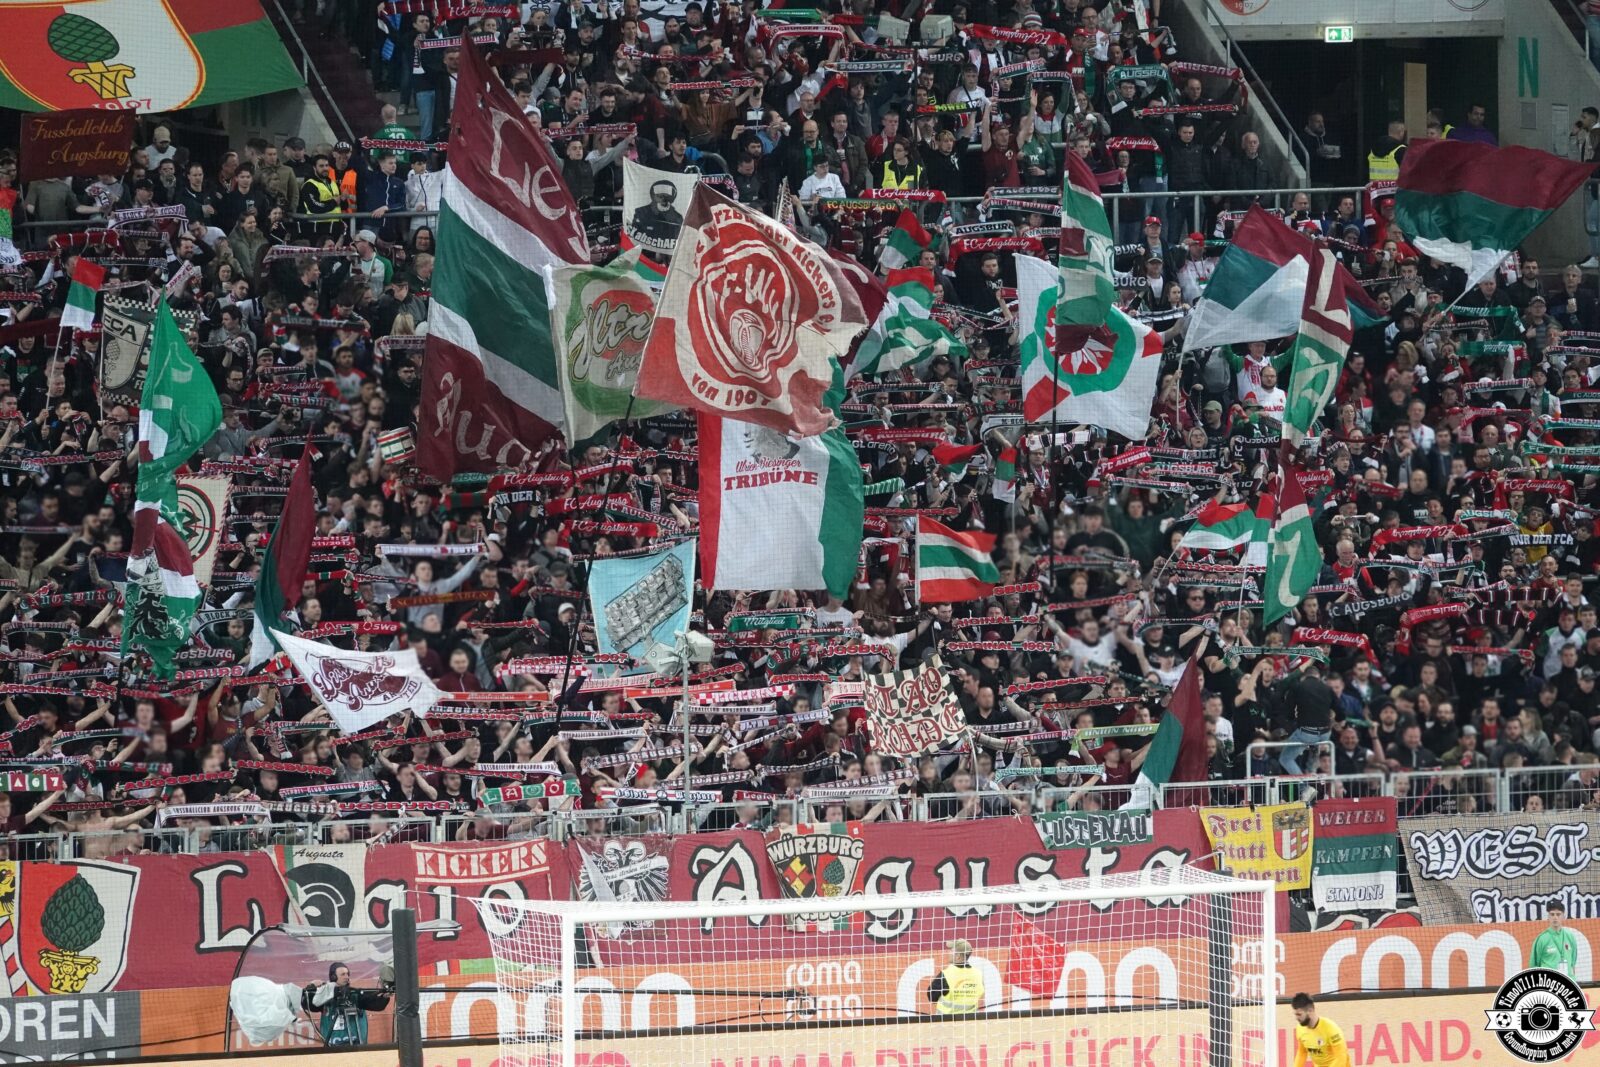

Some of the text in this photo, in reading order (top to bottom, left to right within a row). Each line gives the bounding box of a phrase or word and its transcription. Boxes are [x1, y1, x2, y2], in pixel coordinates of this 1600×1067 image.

[992, 26, 1036, 44] Augsburg
[1518, 37, 1539, 98] N
[936, 103, 967, 111] POWER
[30, 114, 125, 141] Fussballclub
[47, 142, 130, 166] Augsburg
[888, 187, 936, 199] Augsburg
[979, 238, 1030, 250] Augsburg
[792, 244, 837, 310] Kickers
[691, 372, 773, 407] von 1907
[522, 473, 571, 487] Augsburg
[724, 468, 819, 491] TRIBÜNE
[1520, 480, 1567, 492] Augsburg
[511, 491, 533, 503] DER
[1391, 525, 1436, 538] Augsburg
[1508, 533, 1575, 546] NUR DER FCA
[1343, 591, 1412, 616] AUGSBURG
[744, 617, 786, 628] Mitglied
[1319, 627, 1365, 645] Augsburg
[1208, 813, 1264, 838] Frei
[1319, 808, 1387, 827] WEITER
[1041, 811, 1149, 847] LUSTENAU
[292, 847, 345, 859] Augusta
[767, 835, 864, 860] WÜRZBURG
[1315, 845, 1394, 865] KÄMPFEN
[416, 843, 548, 877] KICKERS
[1326, 883, 1385, 903] SIMON!
[786, 960, 862, 987] roma
[785, 994, 863, 1020] roma
